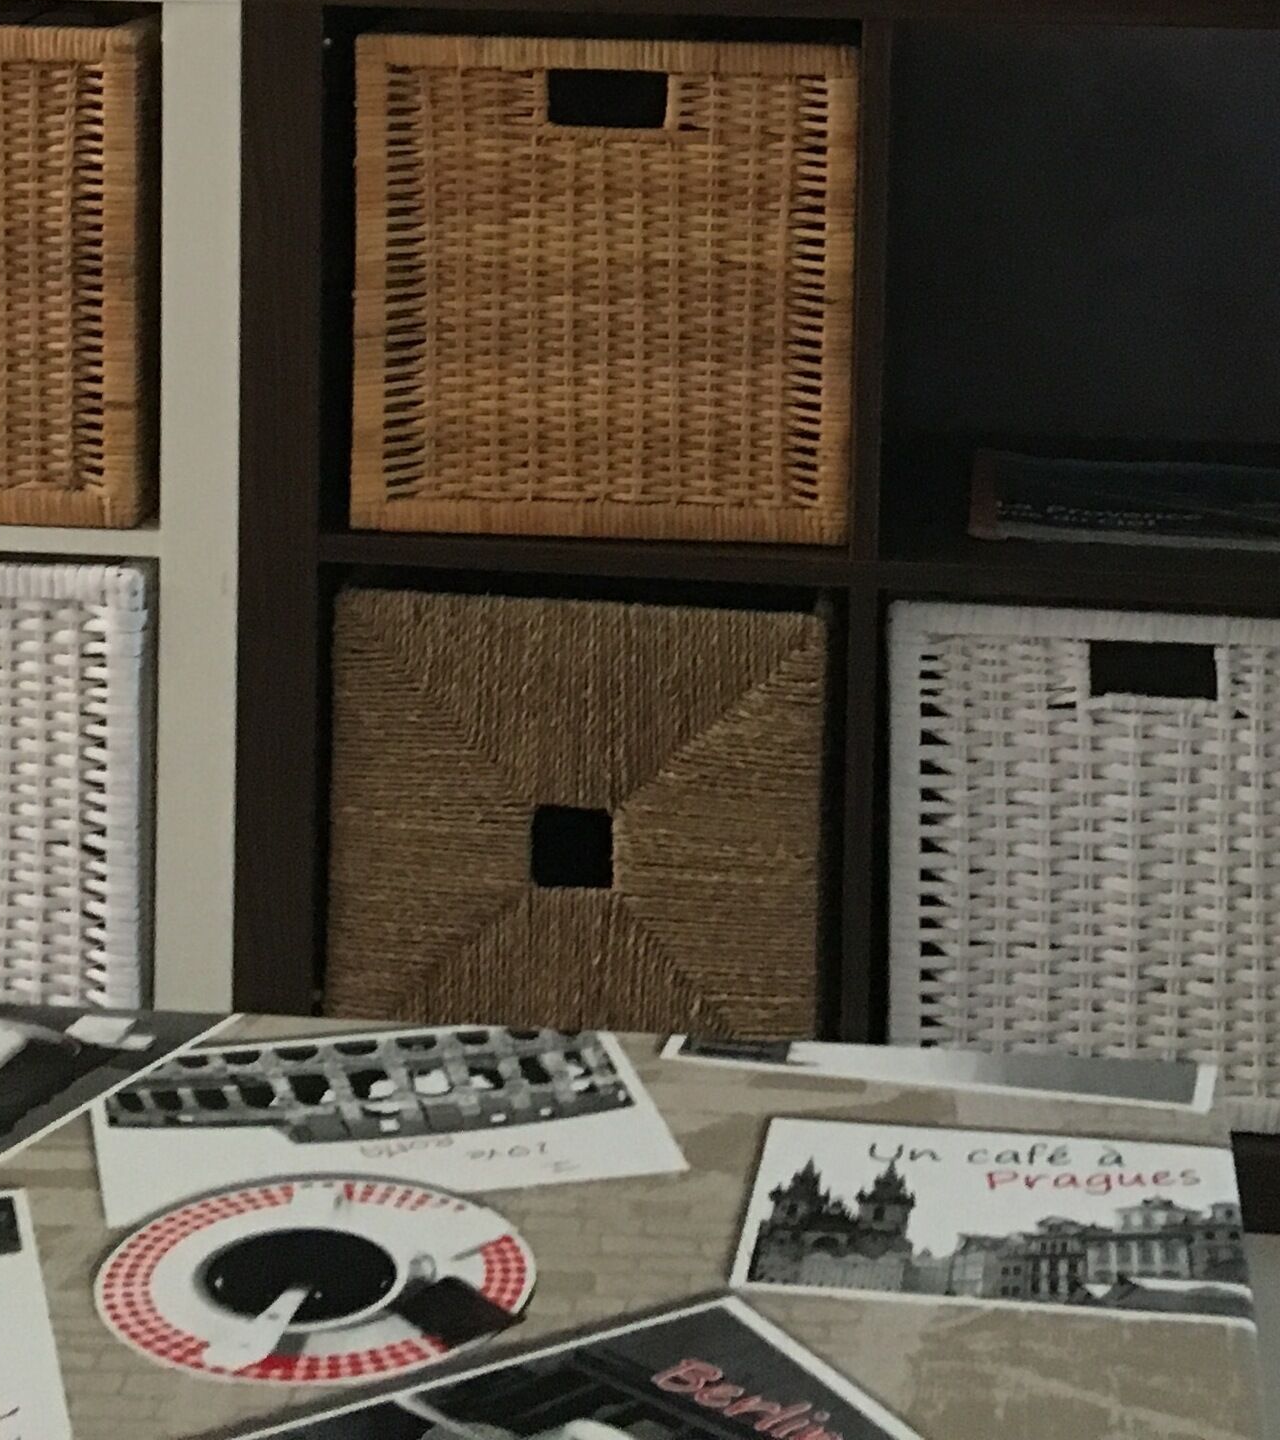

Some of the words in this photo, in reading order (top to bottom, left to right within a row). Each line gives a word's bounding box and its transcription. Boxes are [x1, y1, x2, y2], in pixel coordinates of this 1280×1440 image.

[868, 1142, 942, 1162] Un
[966, 1142, 1073, 1166] café
[986, 1168, 1203, 1196] Pragues
